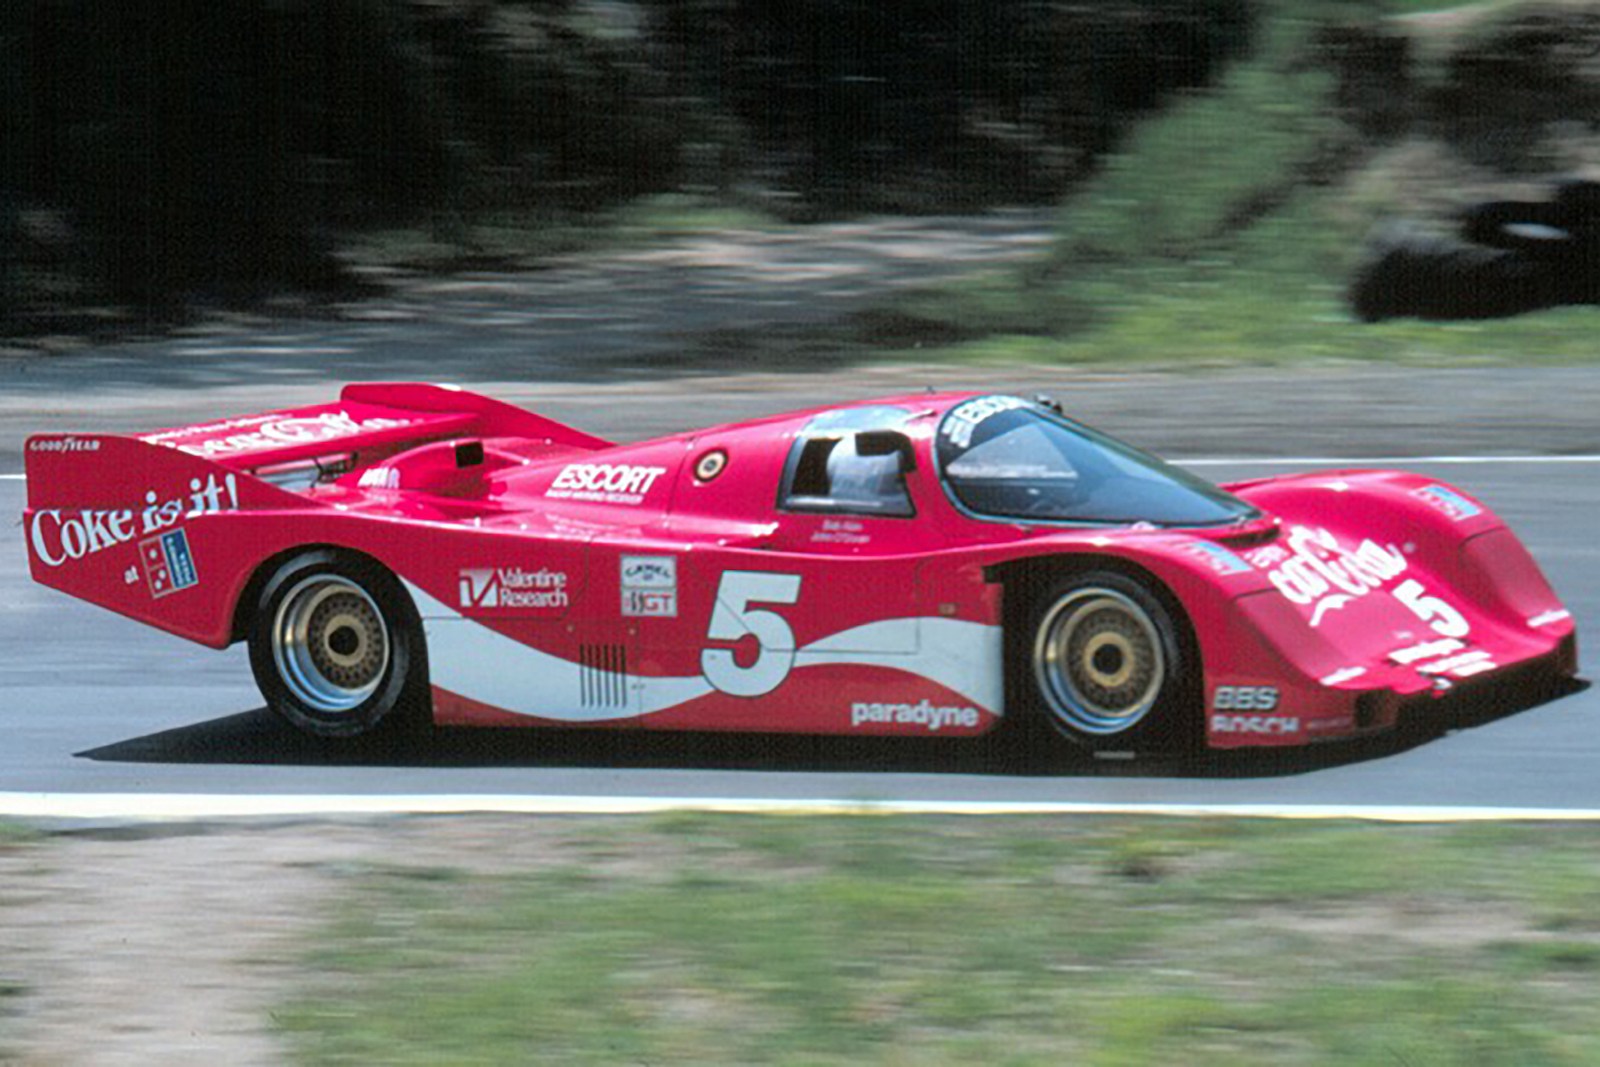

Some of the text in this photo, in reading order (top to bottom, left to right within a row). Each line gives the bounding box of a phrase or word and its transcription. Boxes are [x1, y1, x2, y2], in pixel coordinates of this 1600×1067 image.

[30, 436, 100, 453] GOODYEAR
[551, 464, 667, 493] ESCORT
[31, 509, 136, 566] Coke
[142, 491, 183, 535] is
[185, 473, 239, 519] it!
[498, 566, 567, 587] Valentine
[500, 587, 568, 607] Research
[1391, 578, 1471, 638] 5
[701, 570, 802, 698] 5
[1213, 684, 1279, 711] BBS
[851, 699, 979, 731] paradyne
